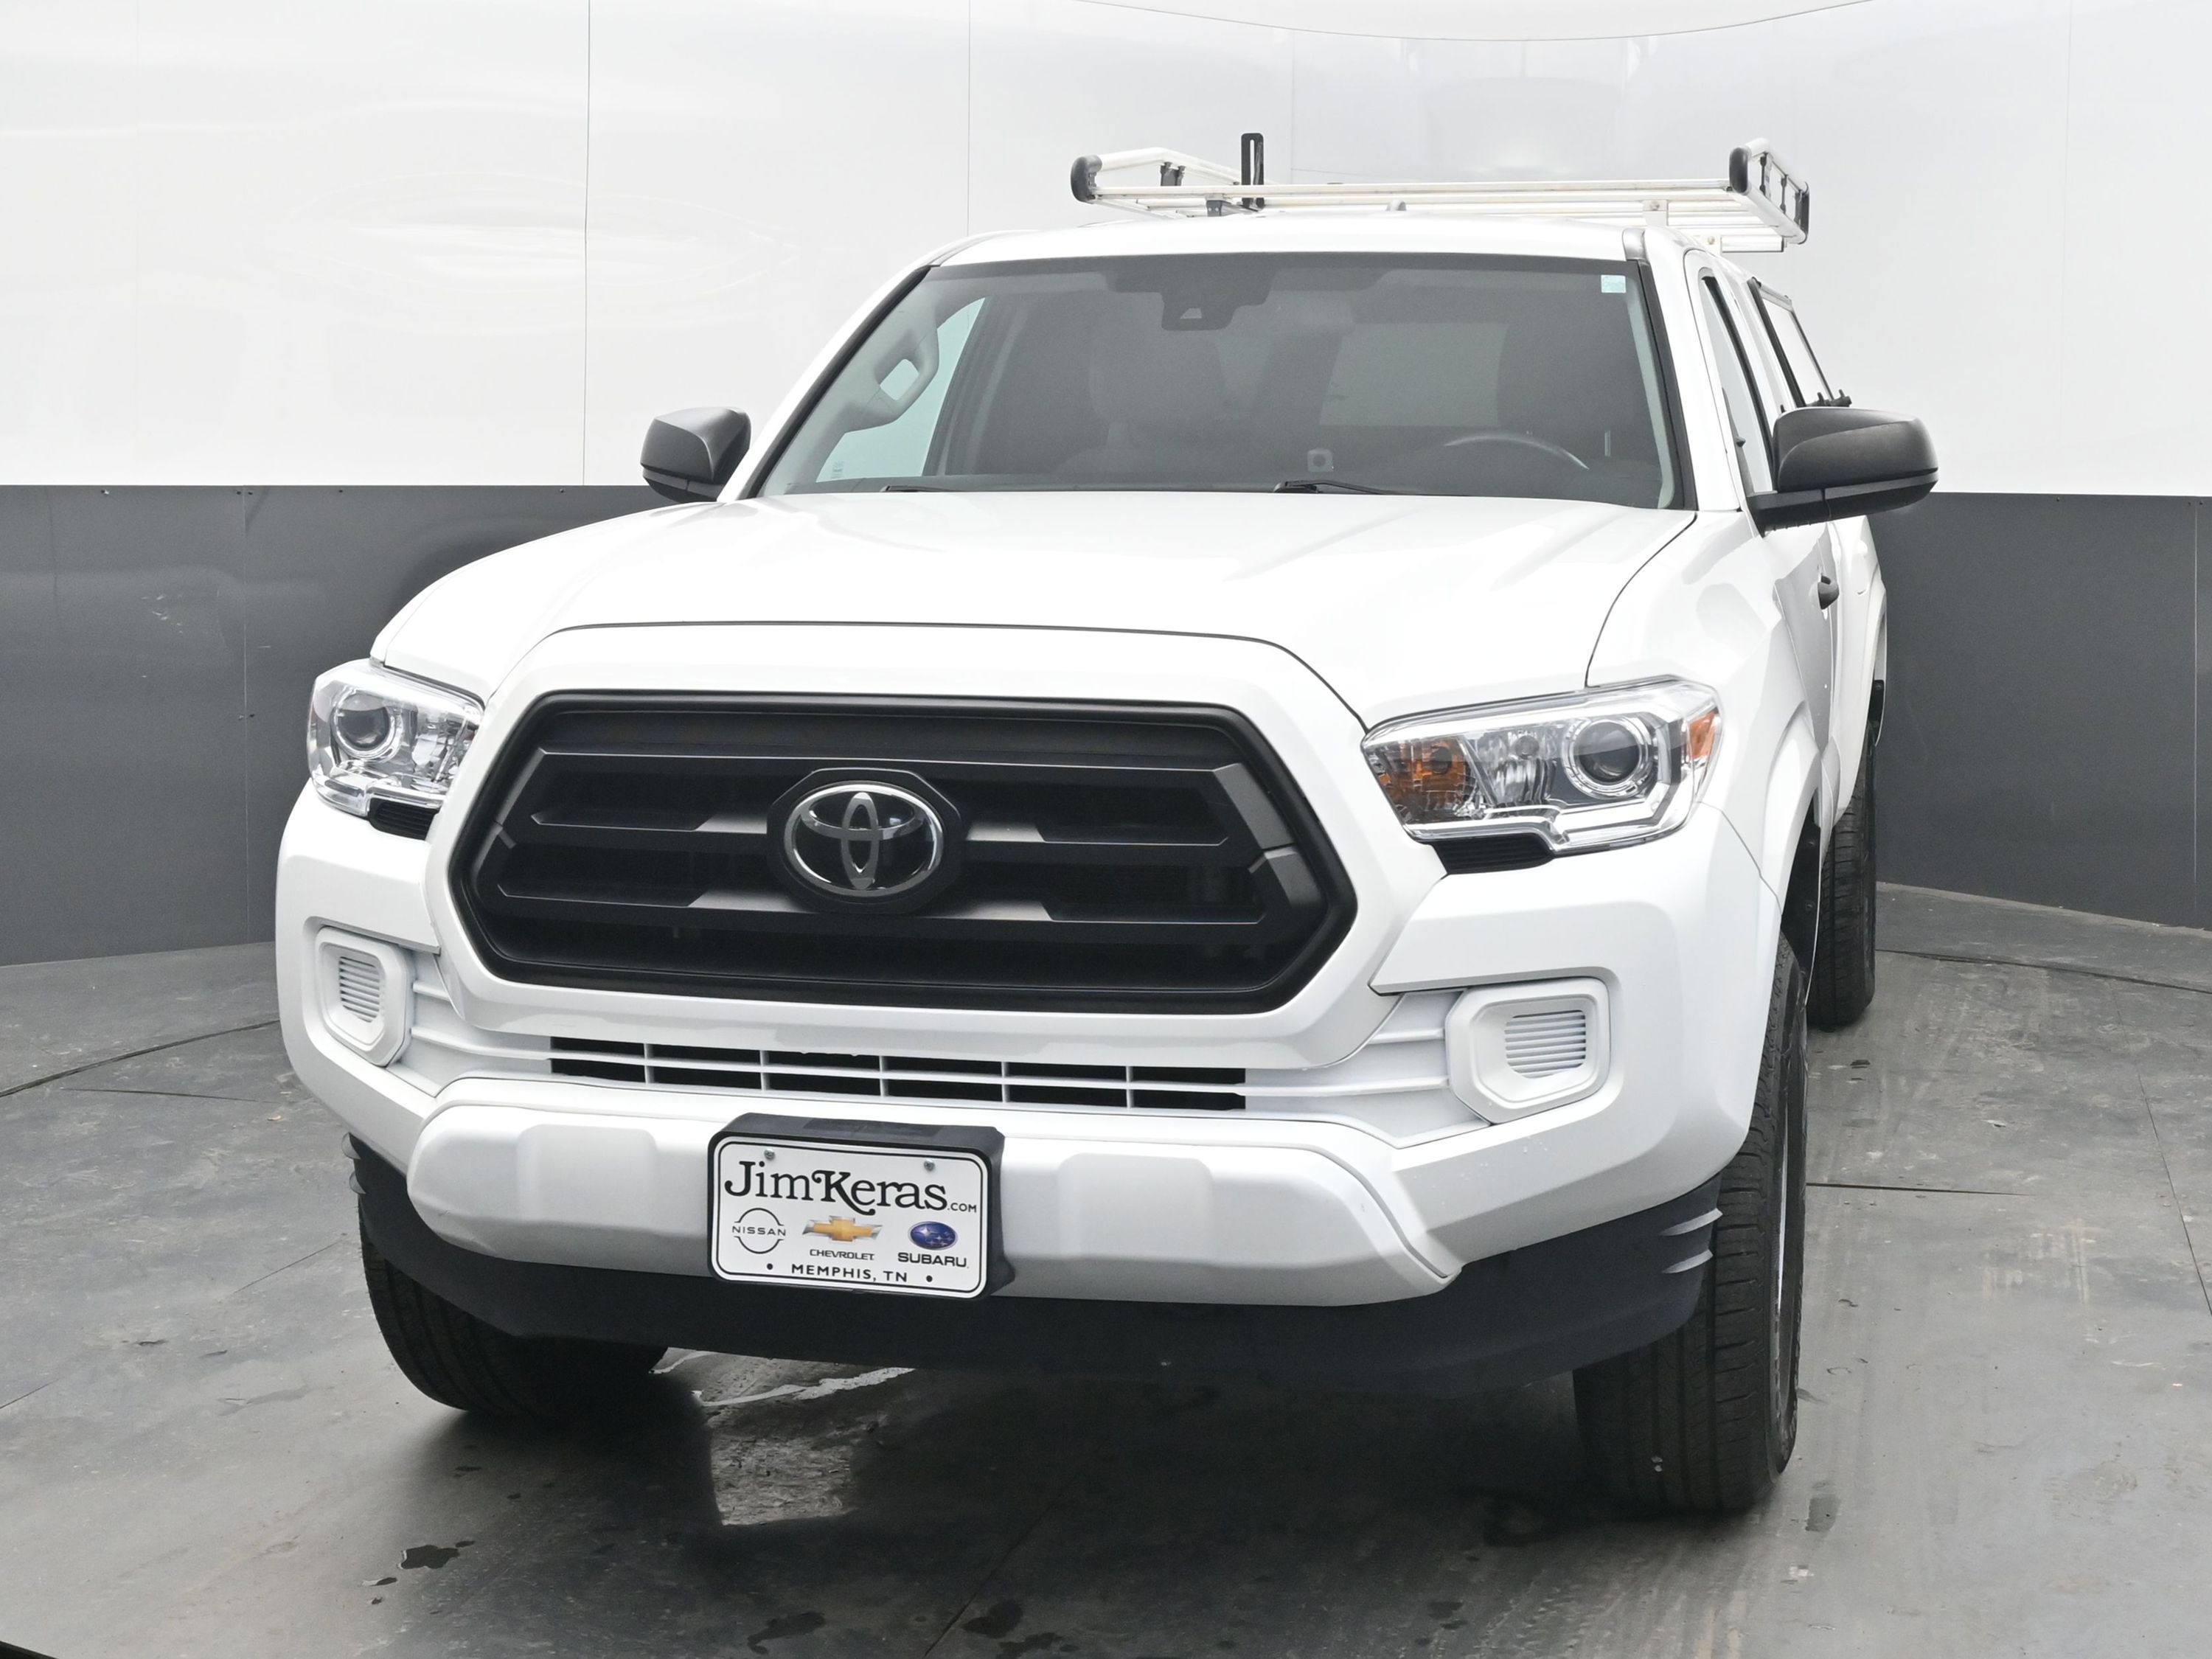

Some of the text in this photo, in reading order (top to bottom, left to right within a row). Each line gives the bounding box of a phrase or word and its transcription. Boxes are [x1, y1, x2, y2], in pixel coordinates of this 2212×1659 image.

[732, 1225, 786, 1237] NISSAN
[810, 1249, 875, 1261] CHEVROLET
[898, 1252, 967, 1267] SUBARU
[791, 1264, 908, 1282] MEMPHIS, TN
